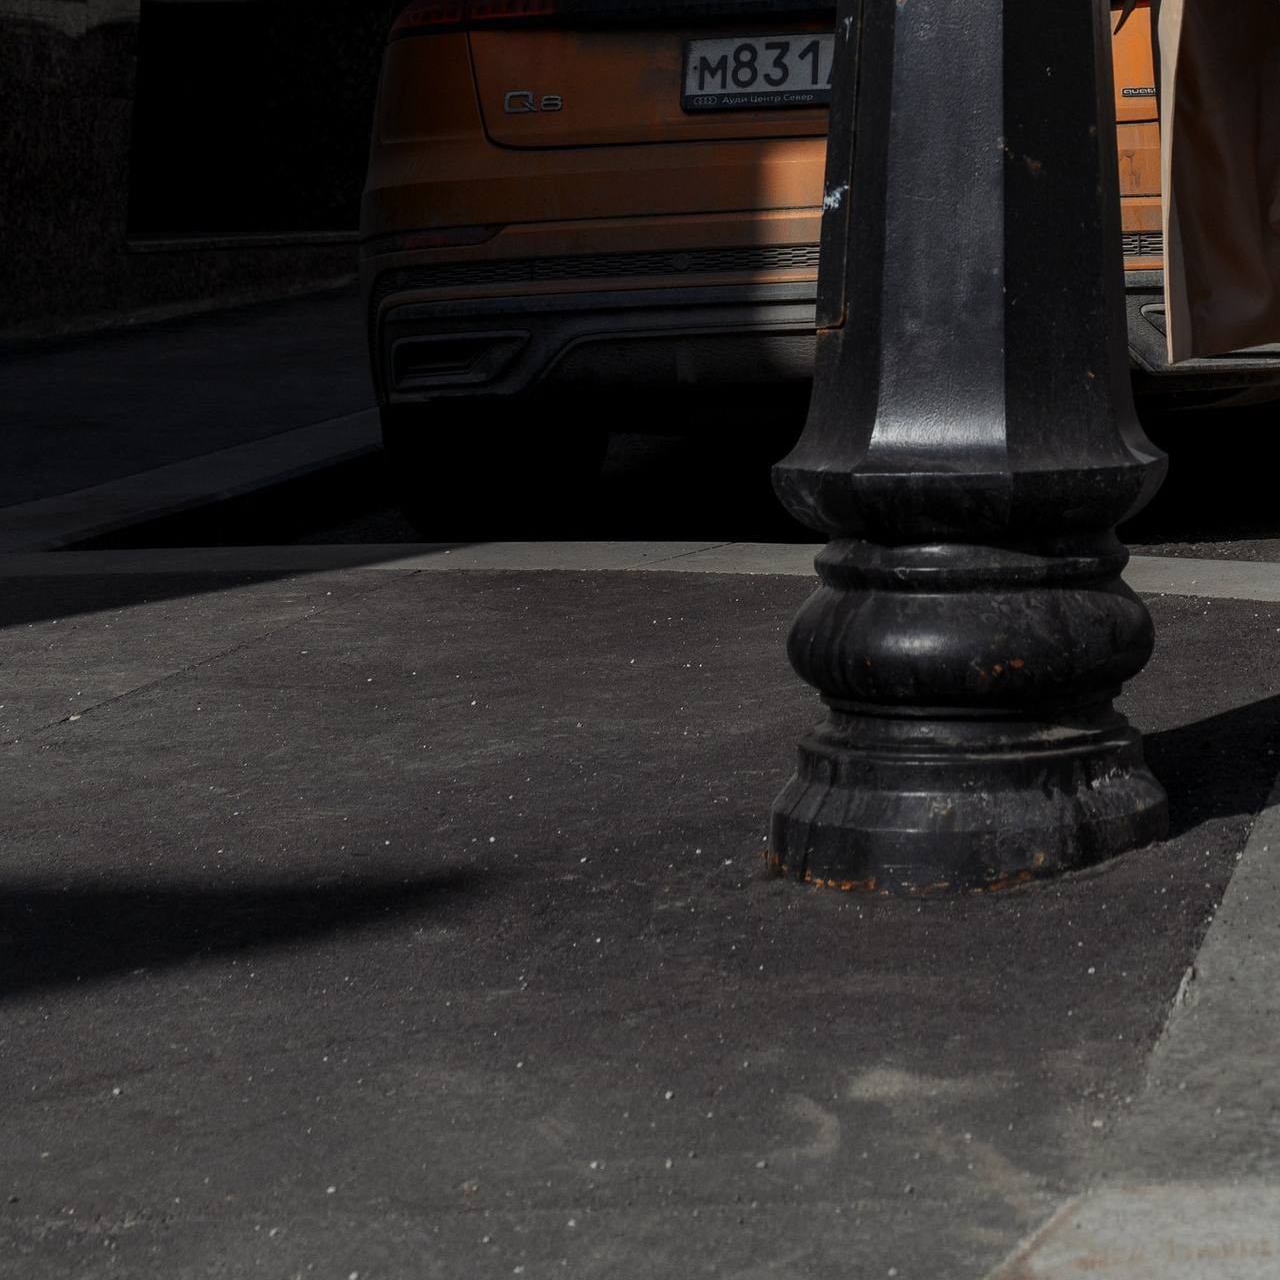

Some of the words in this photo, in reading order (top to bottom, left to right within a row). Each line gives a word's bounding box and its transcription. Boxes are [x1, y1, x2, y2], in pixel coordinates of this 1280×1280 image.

[698, 40, 834, 91] М831
[504, 90, 563, 114] Q8
[722, 96, 748, 105] Ауди
[750, 95, 781, 104] Центр
[783, 93, 814, 102] Север
